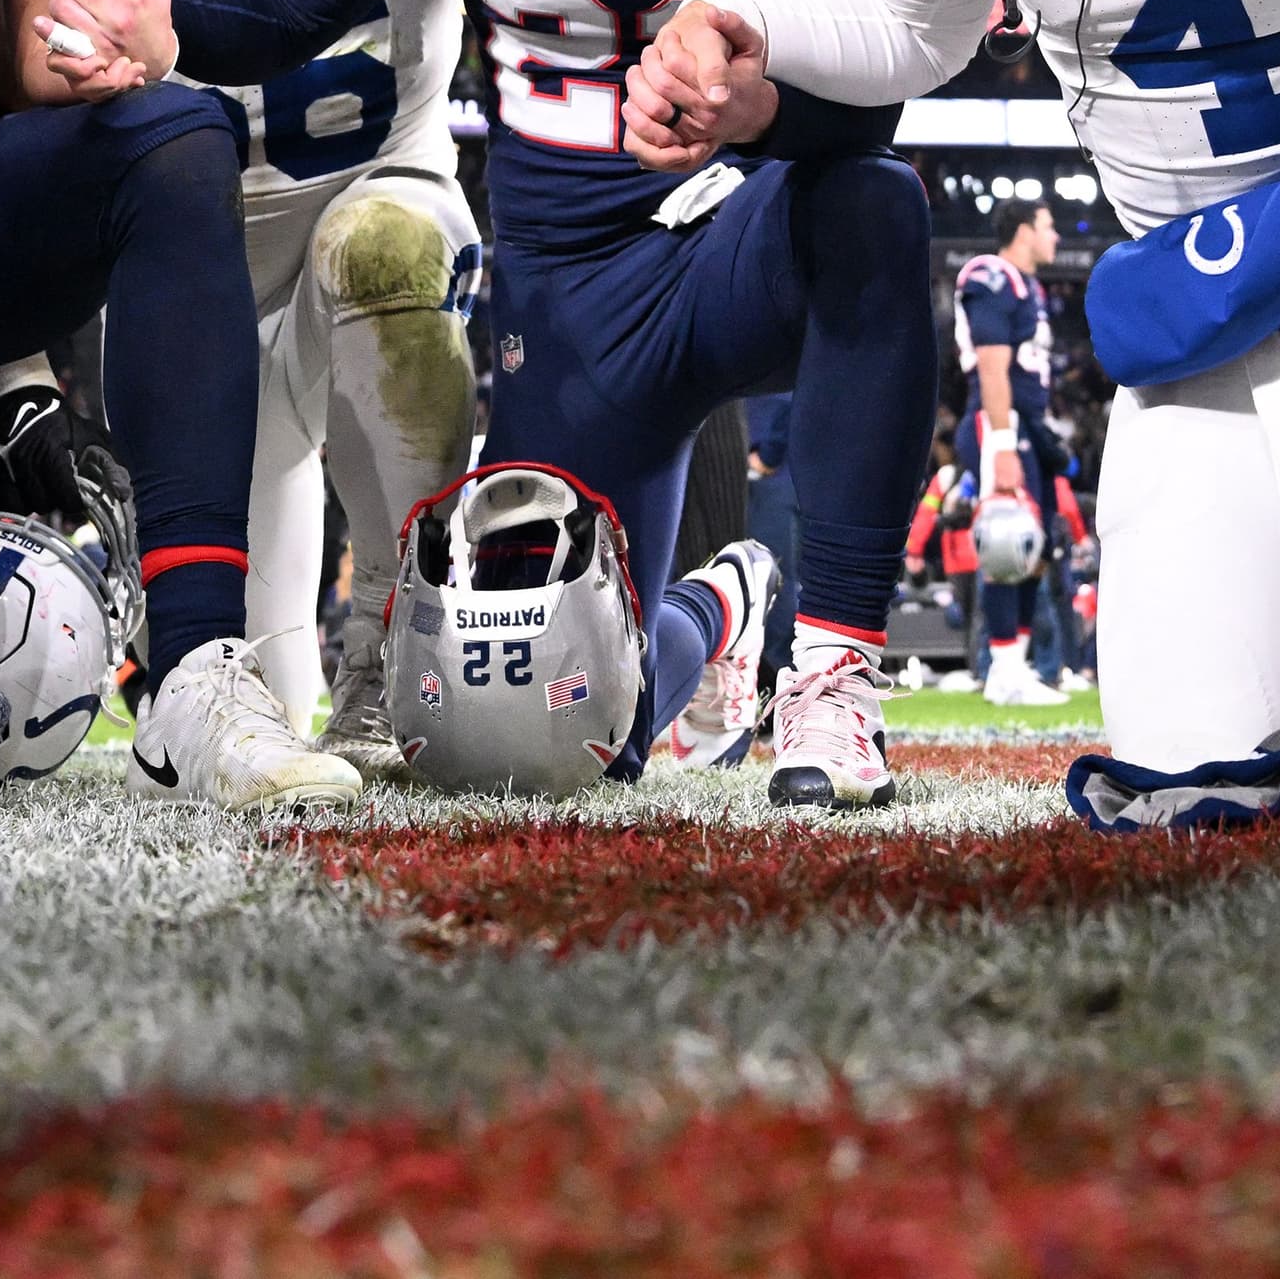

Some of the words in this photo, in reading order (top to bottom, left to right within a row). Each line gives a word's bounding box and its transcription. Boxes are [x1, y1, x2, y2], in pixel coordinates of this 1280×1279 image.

[455, 604, 545, 630] PATRIOTS
[462, 640, 533, 687] 22
[422, 676, 439, 694] NFL
